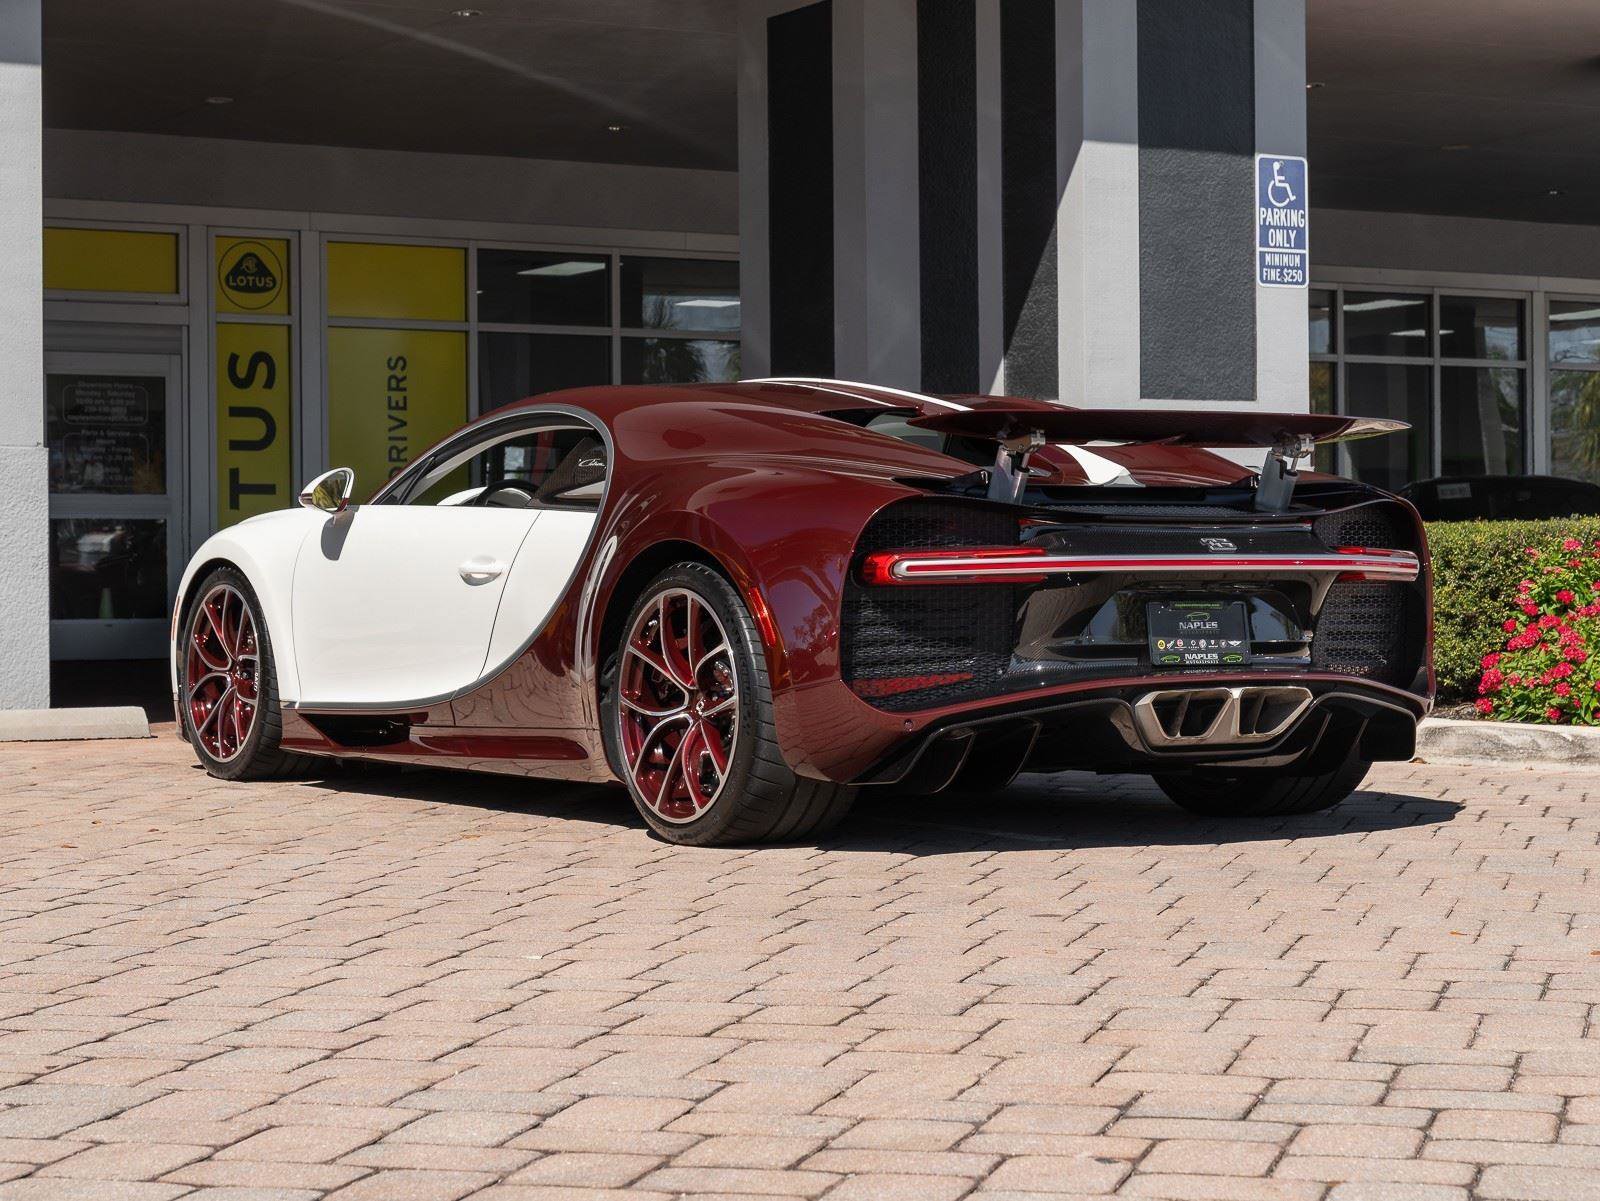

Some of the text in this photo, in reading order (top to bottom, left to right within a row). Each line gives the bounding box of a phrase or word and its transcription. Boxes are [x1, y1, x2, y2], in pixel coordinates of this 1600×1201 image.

[1260, 207, 1305, 228] PARKING
[1268, 229, 1297, 248] ONLY
[1265, 253, 1301, 267] MINIMUM
[229, 275, 274, 288] LOTUS
[1263, 269, 1303, 283] FINE $250
[1179, 621, 1218, 629] NAPLES
